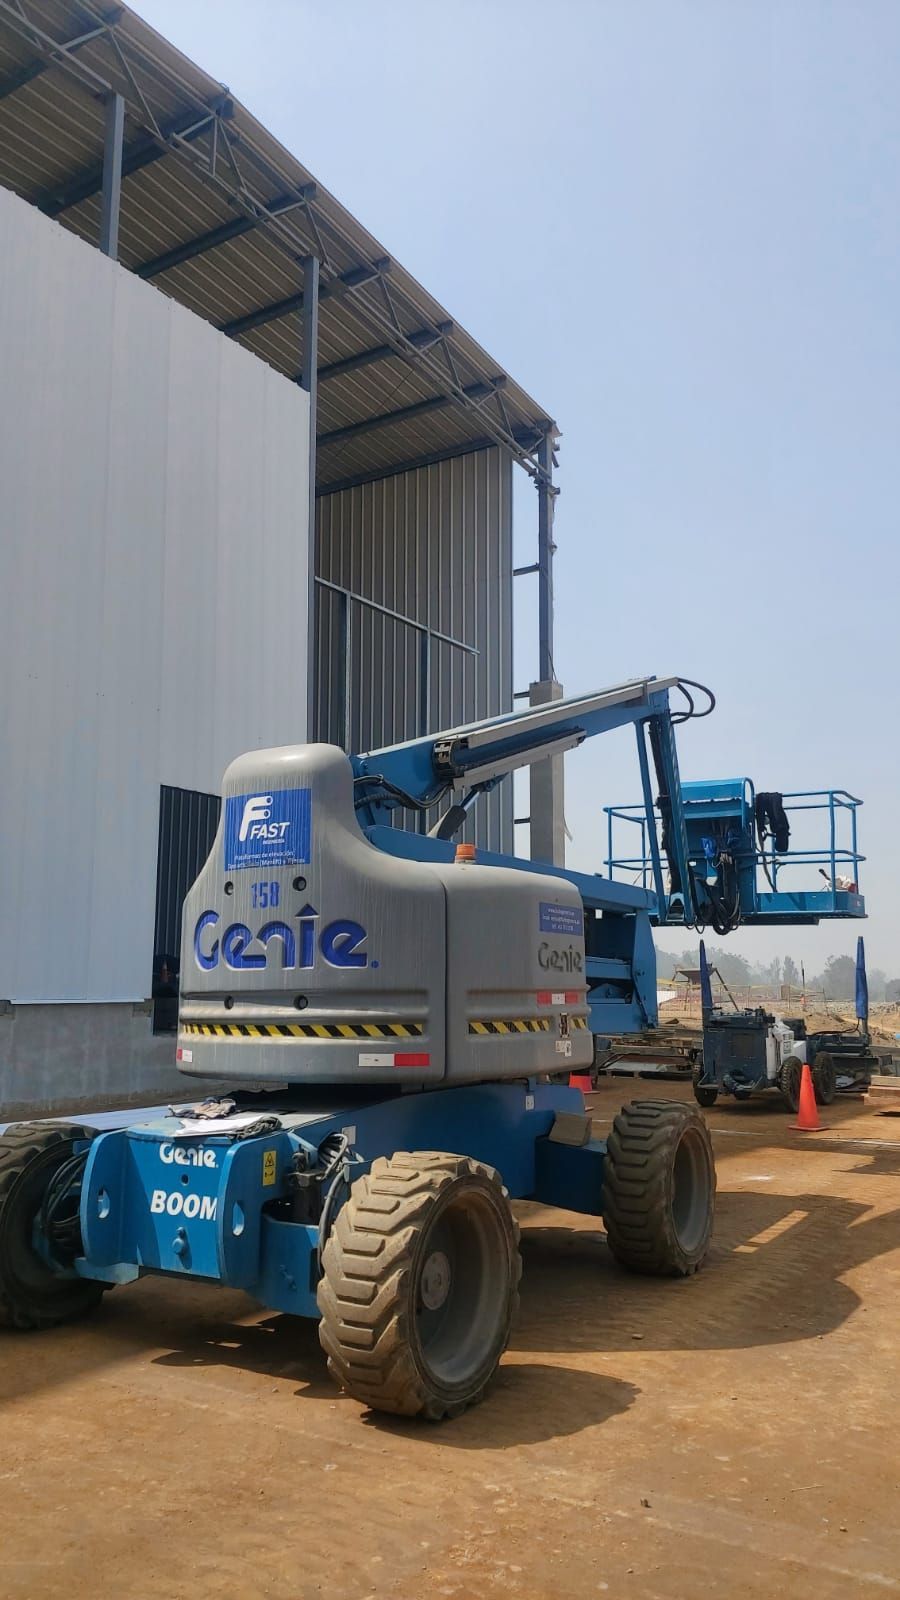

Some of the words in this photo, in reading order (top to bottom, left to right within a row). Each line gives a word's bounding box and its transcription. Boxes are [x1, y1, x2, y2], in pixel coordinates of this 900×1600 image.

[250, 822, 290, 840] FAST
[251, 881, 280, 909] 158
[538, 942, 583, 973] Genie
[150, 1190, 218, 1221] BOOM
